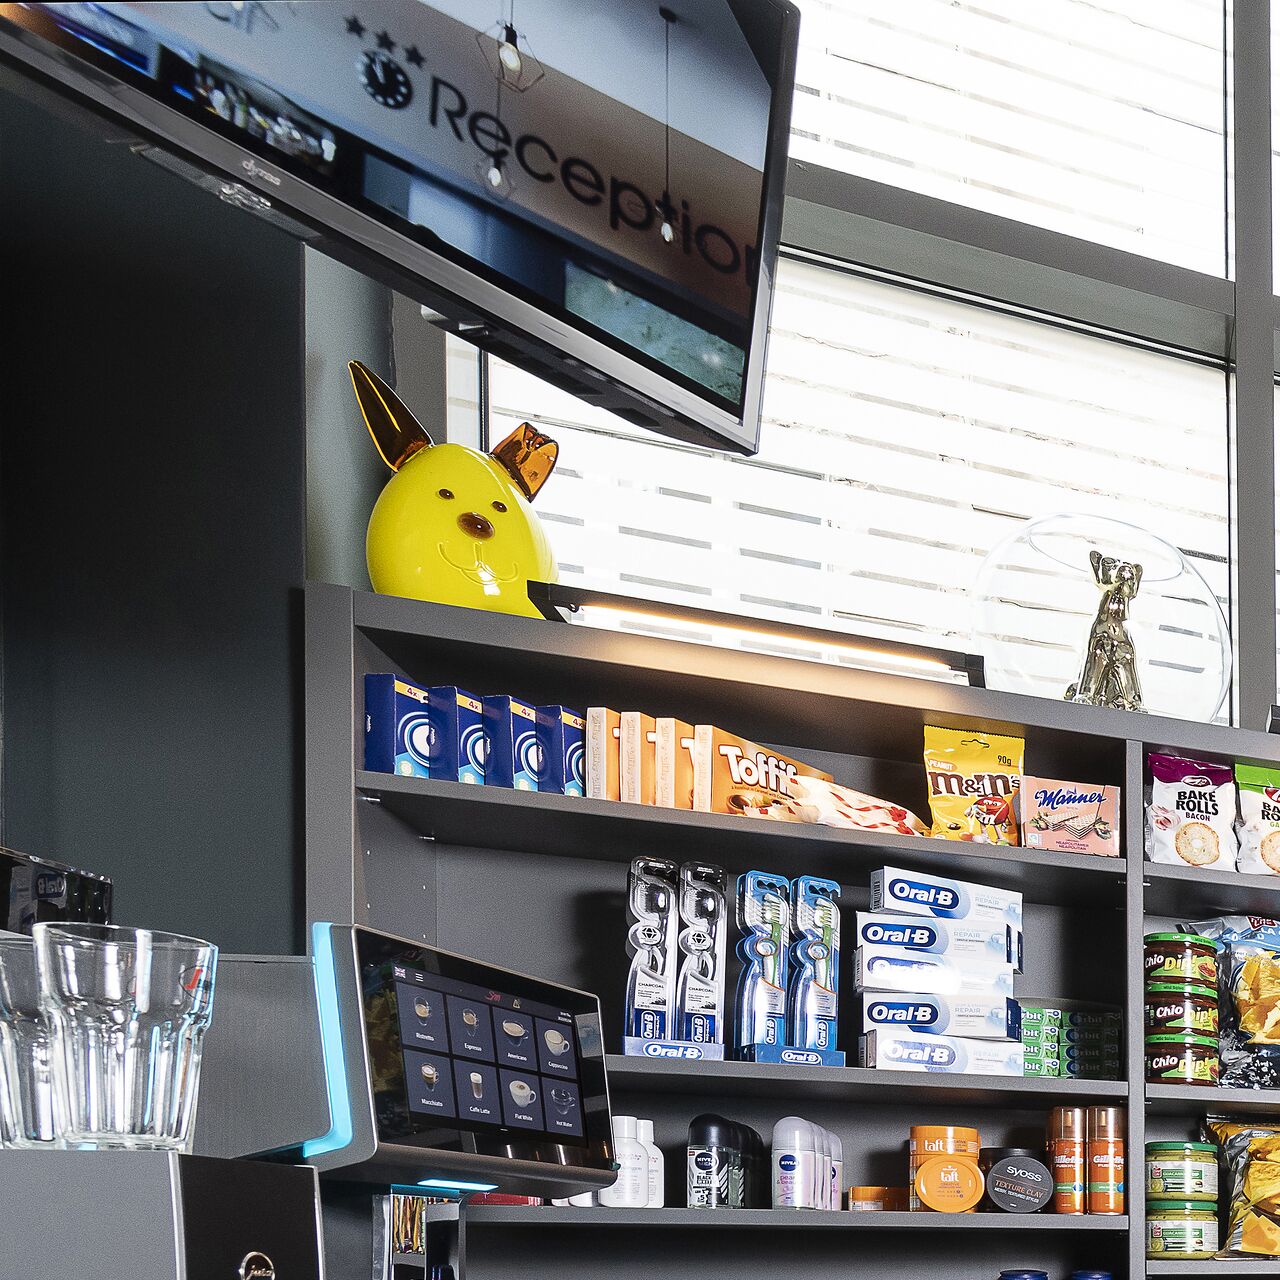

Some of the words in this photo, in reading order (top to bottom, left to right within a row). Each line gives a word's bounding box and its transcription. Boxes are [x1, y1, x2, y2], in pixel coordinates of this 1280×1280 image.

[430, 76, 757, 287] Recepio
[997, 754, 1012, 767] 90g
[719, 745, 800, 799] Toffif
[1034, 786, 1107, 811] Manner
[1177, 790, 1216, 803] BAKE
[1176, 800, 1219, 816] ROLLS
[1185, 811, 1211, 822] BACON
[893, 882, 953, 906] Oral-B
[867, 926, 930, 944] Oral-B
[1145, 954, 1164, 968] Chio
[872, 1005, 932, 1022] Oral-B
[1156, 1004, 1184, 1018] Chio
[650, 1044, 701, 1059] Oral-B
[784, 1052, 819, 1062] Oral-B
[887, 1043, 949, 1063] Oral-B
[1152, 1055, 1178, 1069] Chio
[925, 1140, 945, 1152] taft
[940, 1170, 959, 1182] taft
[1006, 1165, 1042, 1182] syoss
[995, 1179, 1026, 1194] TEXTURE
[1026, 1187, 1044, 1199] CLAY
